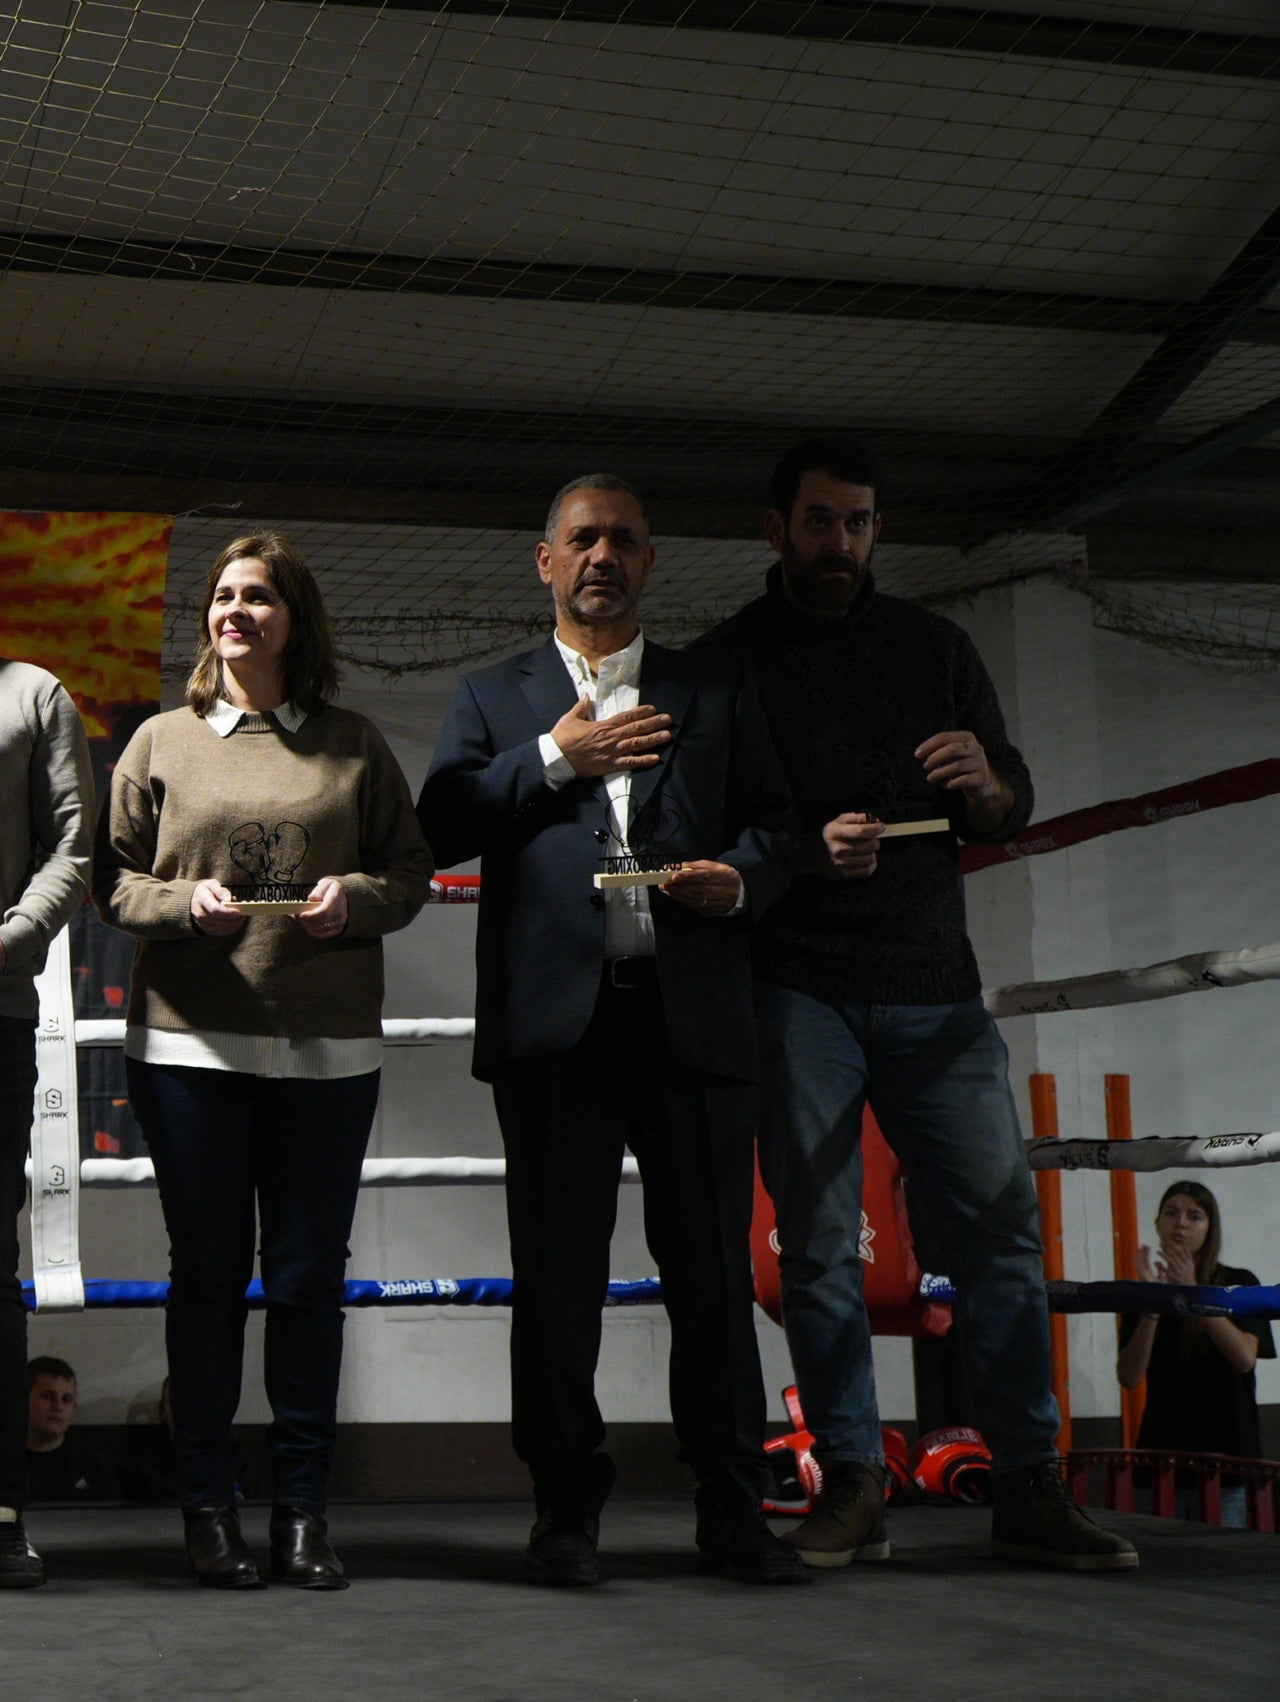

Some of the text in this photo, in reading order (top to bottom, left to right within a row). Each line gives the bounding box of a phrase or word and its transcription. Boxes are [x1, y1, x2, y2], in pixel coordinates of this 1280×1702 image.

[447, 886, 480, 899] SHA
[39, 1034, 66, 1042] SHARK
[40, 1111, 68, 1120] SHARK
[380, 1283, 434, 1298] SHARK
